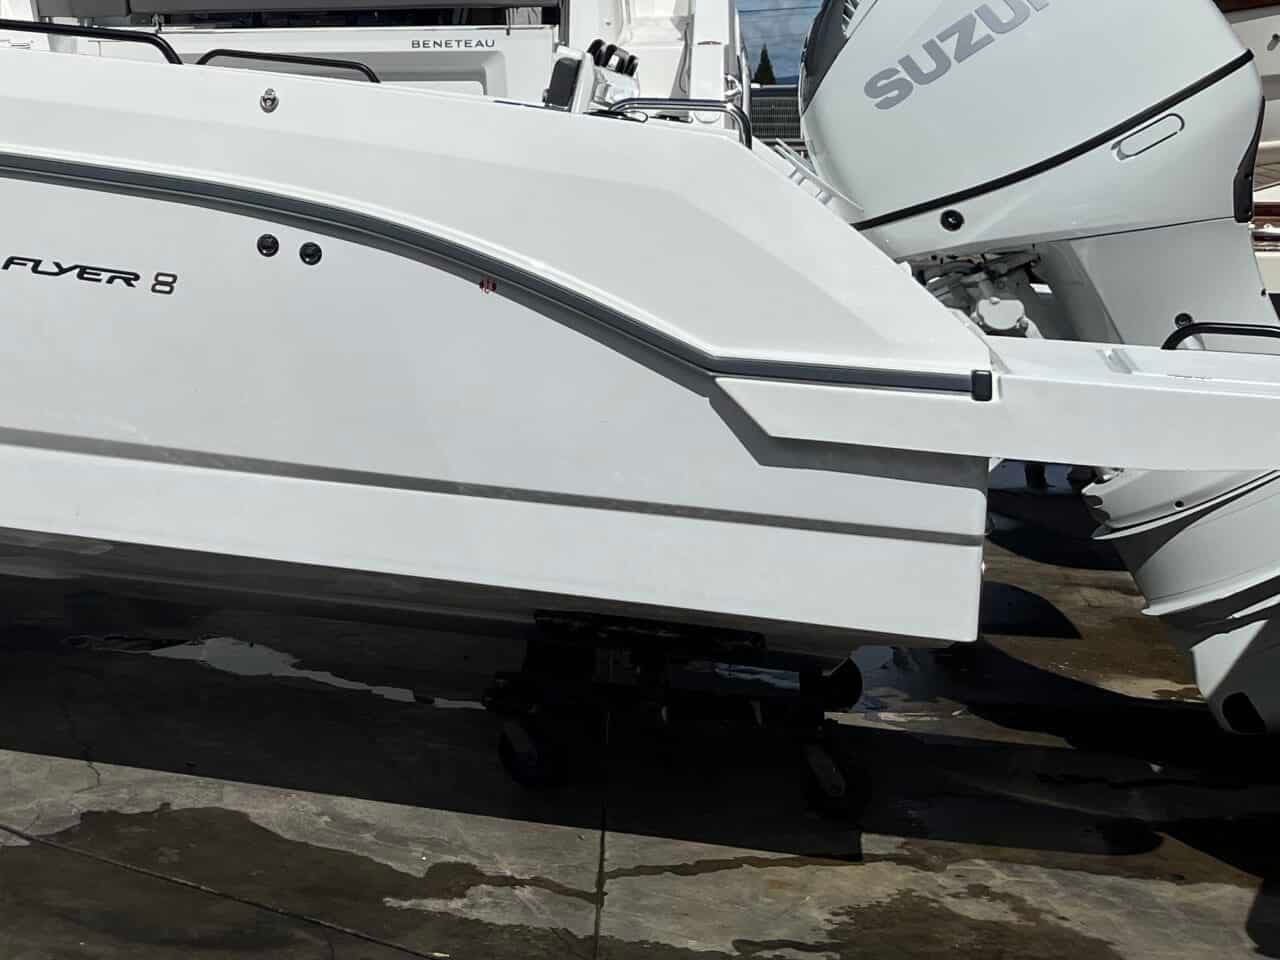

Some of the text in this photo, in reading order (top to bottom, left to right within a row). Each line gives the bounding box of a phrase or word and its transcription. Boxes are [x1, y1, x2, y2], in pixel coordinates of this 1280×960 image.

[411, 39, 495, 49] BENETEAU
[1, 256, 178, 295] FLYER 8
